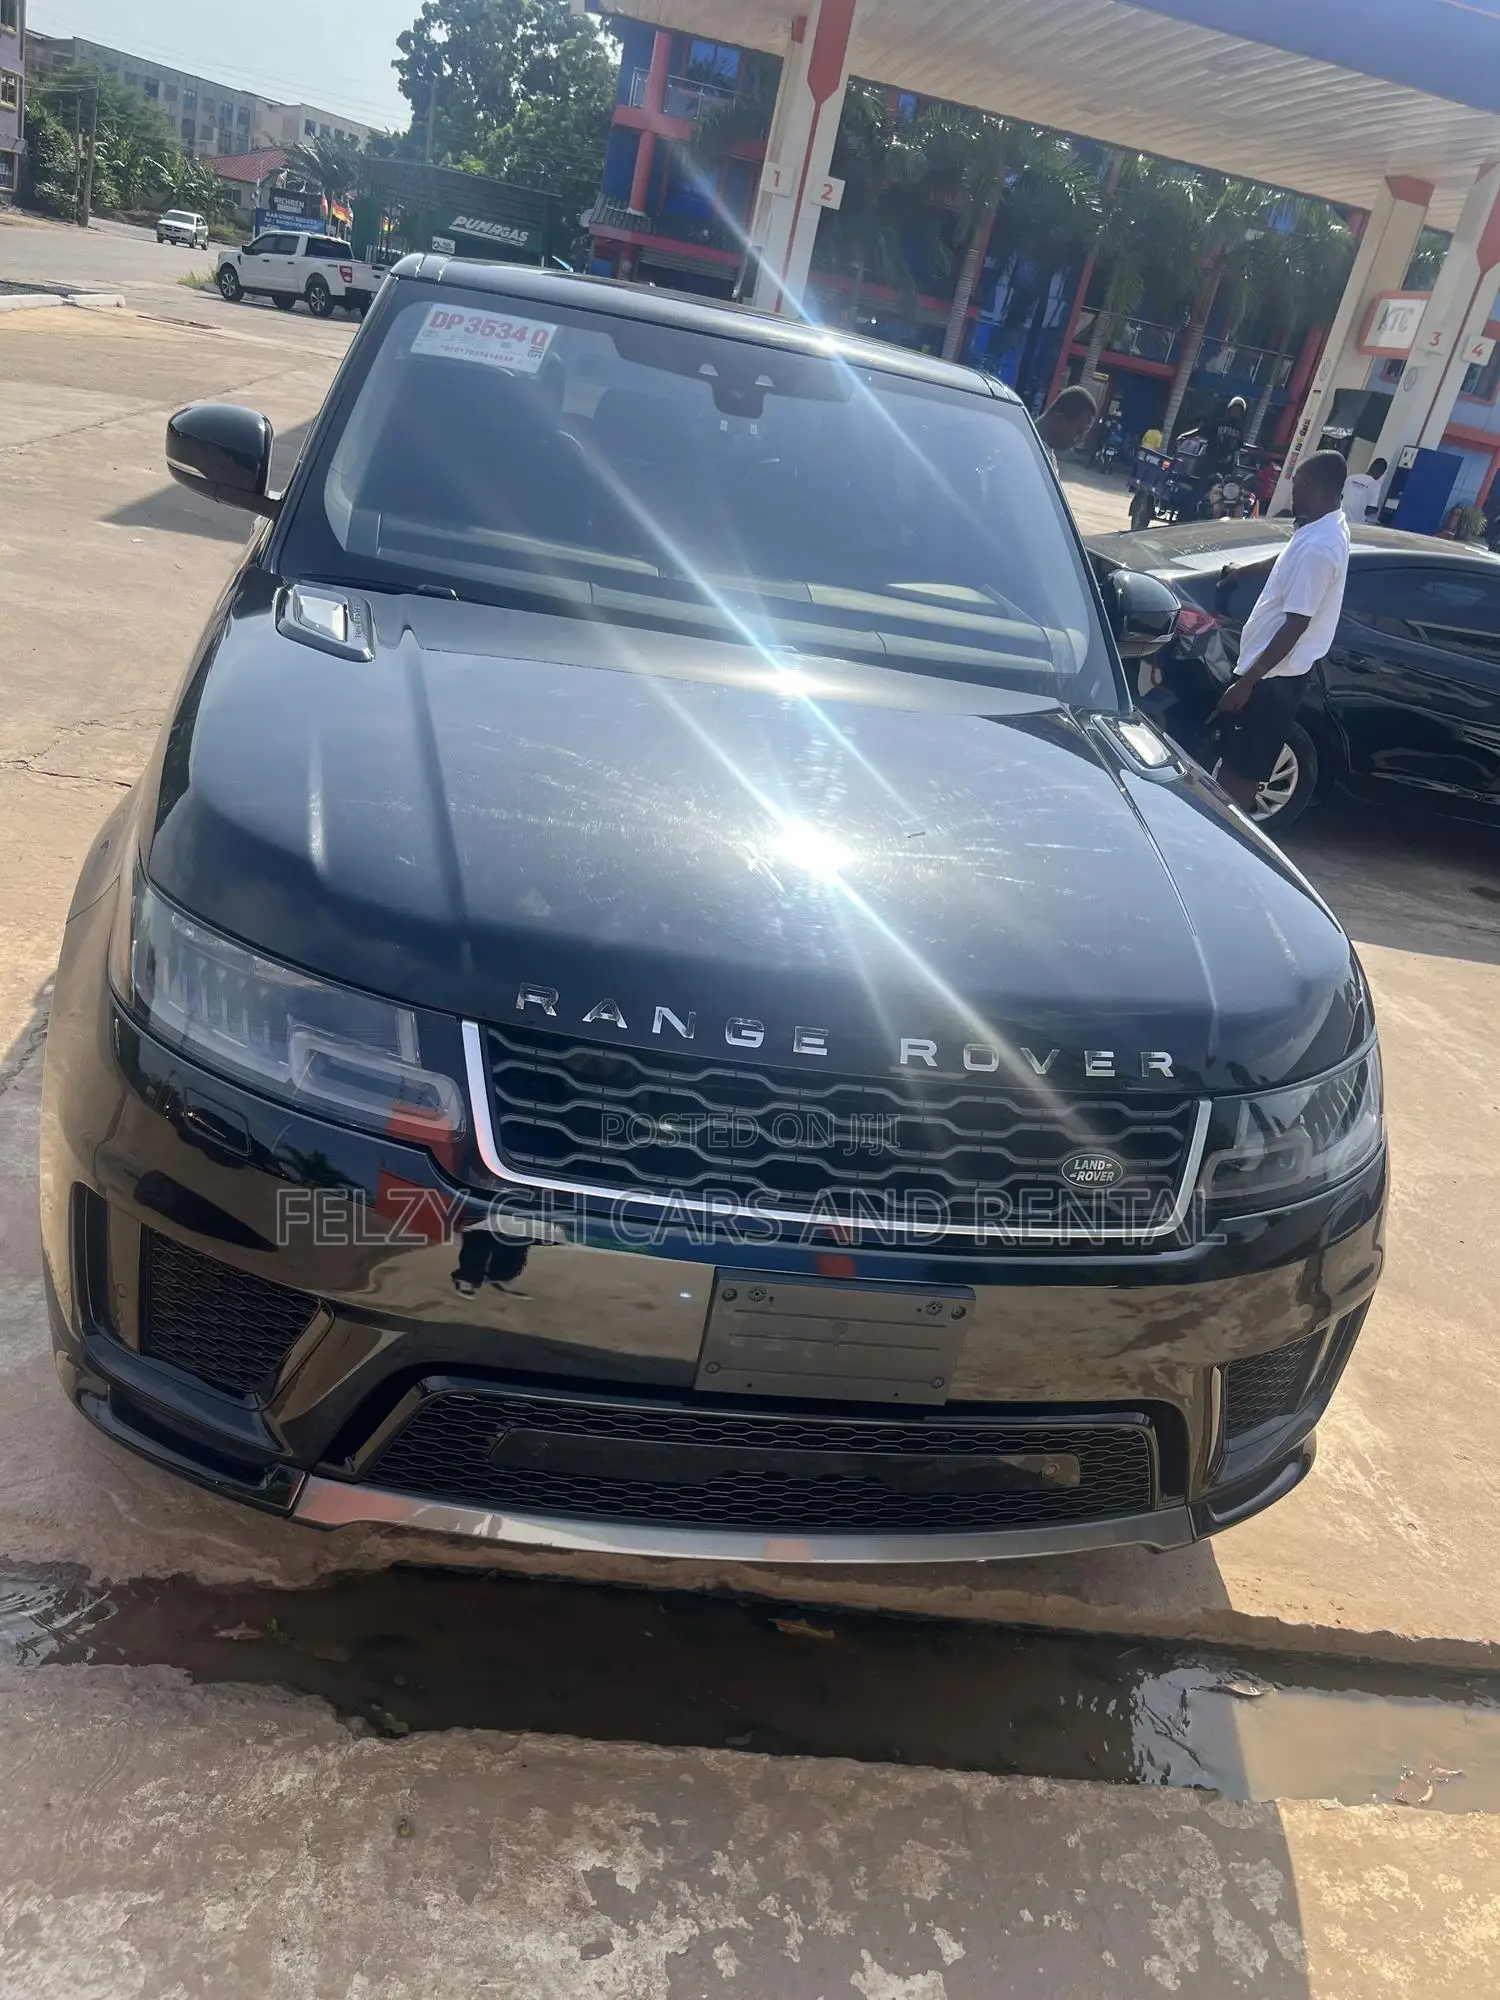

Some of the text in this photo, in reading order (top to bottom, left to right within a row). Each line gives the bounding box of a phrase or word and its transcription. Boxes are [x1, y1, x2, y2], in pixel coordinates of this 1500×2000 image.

[773, 170, 781, 188] 1
[820, 183, 834, 202] 2
[428, 311, 465, 330] DP
[1428, 331, 1442, 347] 3
[1471, 343, 1484, 358] 4
[516, 981, 1175, 1078] RANGE ROVER
[1074, 1159, 1106, 1171] LAND
[1076, 1170, 1115, 1182] ROVER
